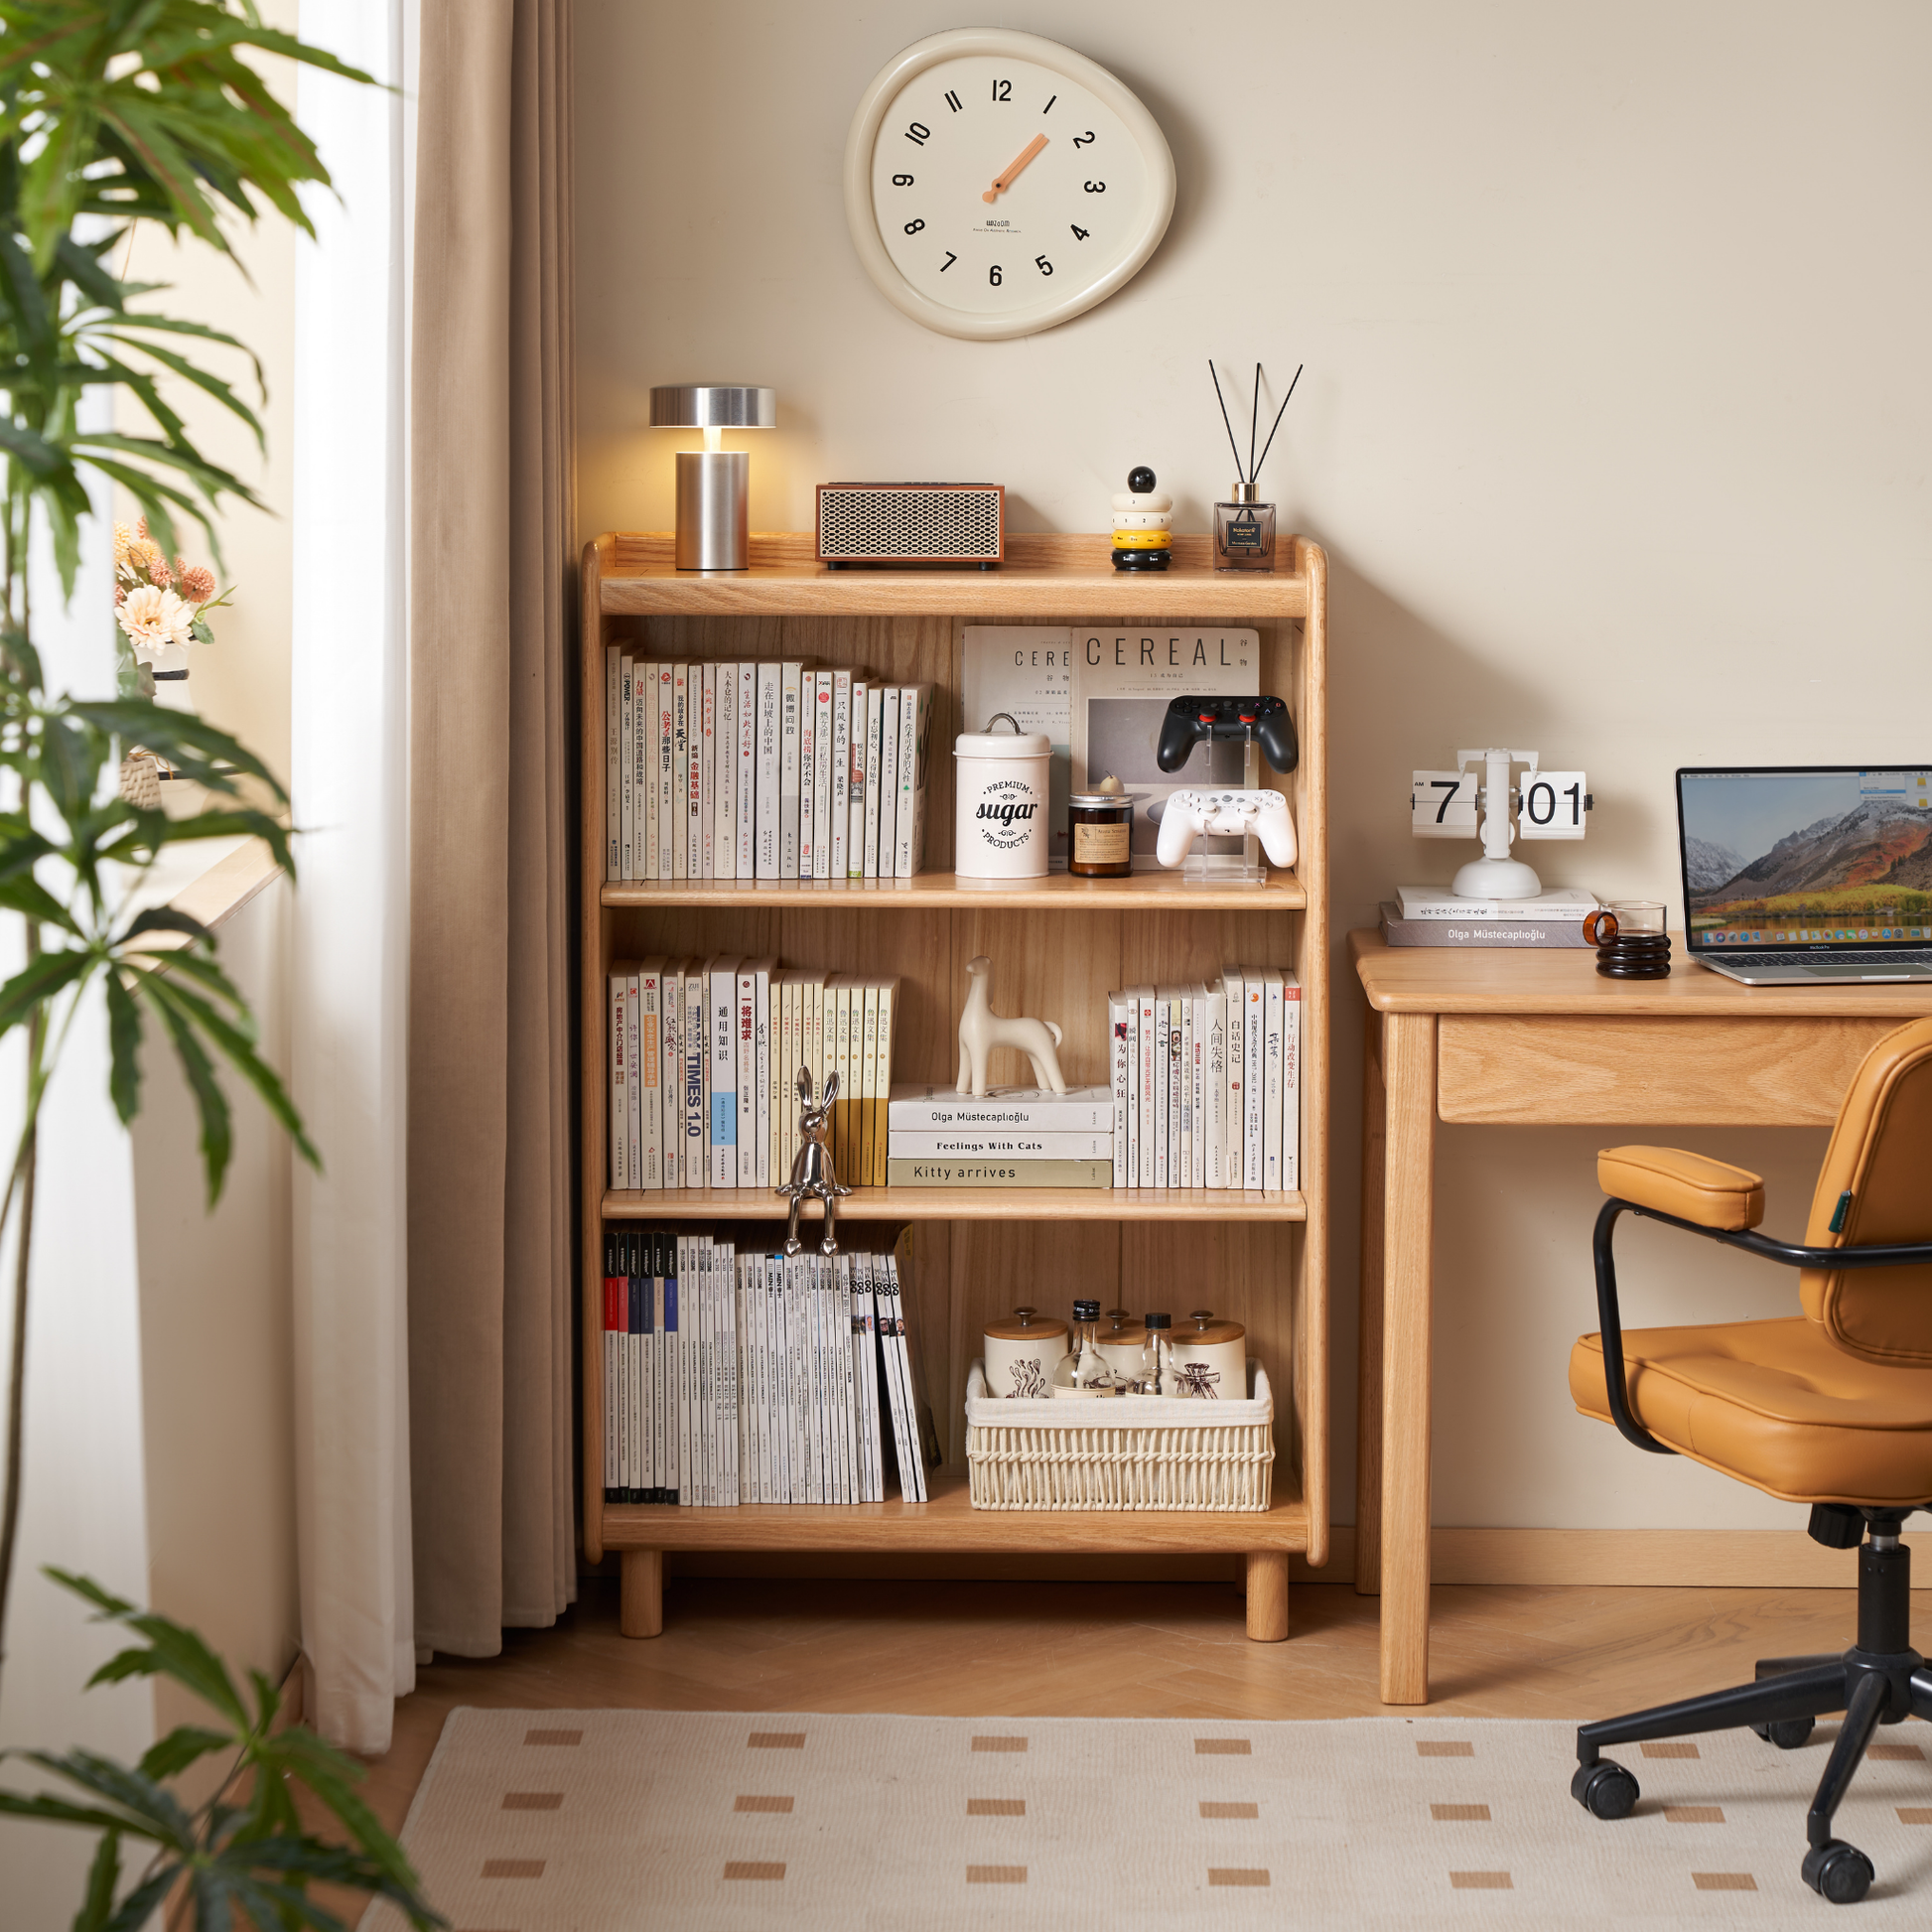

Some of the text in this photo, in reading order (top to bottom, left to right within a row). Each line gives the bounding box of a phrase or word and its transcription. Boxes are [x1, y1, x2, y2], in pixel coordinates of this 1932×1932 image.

[944, 89, 963, 113] 11
[992, 79, 1012, 101] 12
[1042, 95, 1057, 114] 1
[904, 122, 931, 146] 10
[1072, 131, 1096, 149] 2
[892, 174, 914, 187] 9
[1083, 181, 1106, 194] 3
[903, 218, 925, 235] 8
[1070, 223, 1090, 241] 4
[939, 251, 957, 273] 7
[1035, 254, 1053, 276] 5
[989, 264, 1003, 287] 6
[1086, 637, 1231, 666] CEREAL
[742, 689, 752, 749] 生活如此美好
[763, 681, 773, 755] 走在山坡上的中国
[785, 693, 795, 735] 微博问政
[835, 692, 847, 767] 一只风筝的一生
[802, 729, 812, 786] 海底捞你学不会
[902, 724, 912, 782] 你不可不知的人性
[987, 780, 1030, 793] PREMIUM
[1431, 780, 1460, 824] 7
[1527, 782, 1581, 826] 01
[976, 803, 1038, 827] sugar
[983, 832, 1030, 849] PRODUCTS
[1448, 929, 1546, 941] Olga Müstecaplıoğlu
[718, 1006, 729, 1061] 通用知识
[1231, 1020, 1241, 1064] 白话史记
[1210, 1019, 1223, 1073] 人间失格
[1116, 1043, 1127, 1098] 为你心狂
[1287, 1033, 1296, 1089] 行动改变生存
[687, 1052, 702, 1137] TIMES 1.0
[931, 1111, 1030, 1123] Olga Müstecaplıoğlu
[936, 1142, 984, 1152] Feelings
[913, 1167, 1016, 1180] Kitty arrives
[850, 1280, 858, 1294] GQ
[857, 1281, 865, 1295] GQ
[864, 1280, 872, 1293] GQ
[876, 1282, 884, 1296] GQ
[883, 1283, 891, 1297] GQ
[892, 1282, 899, 1297] GQ
